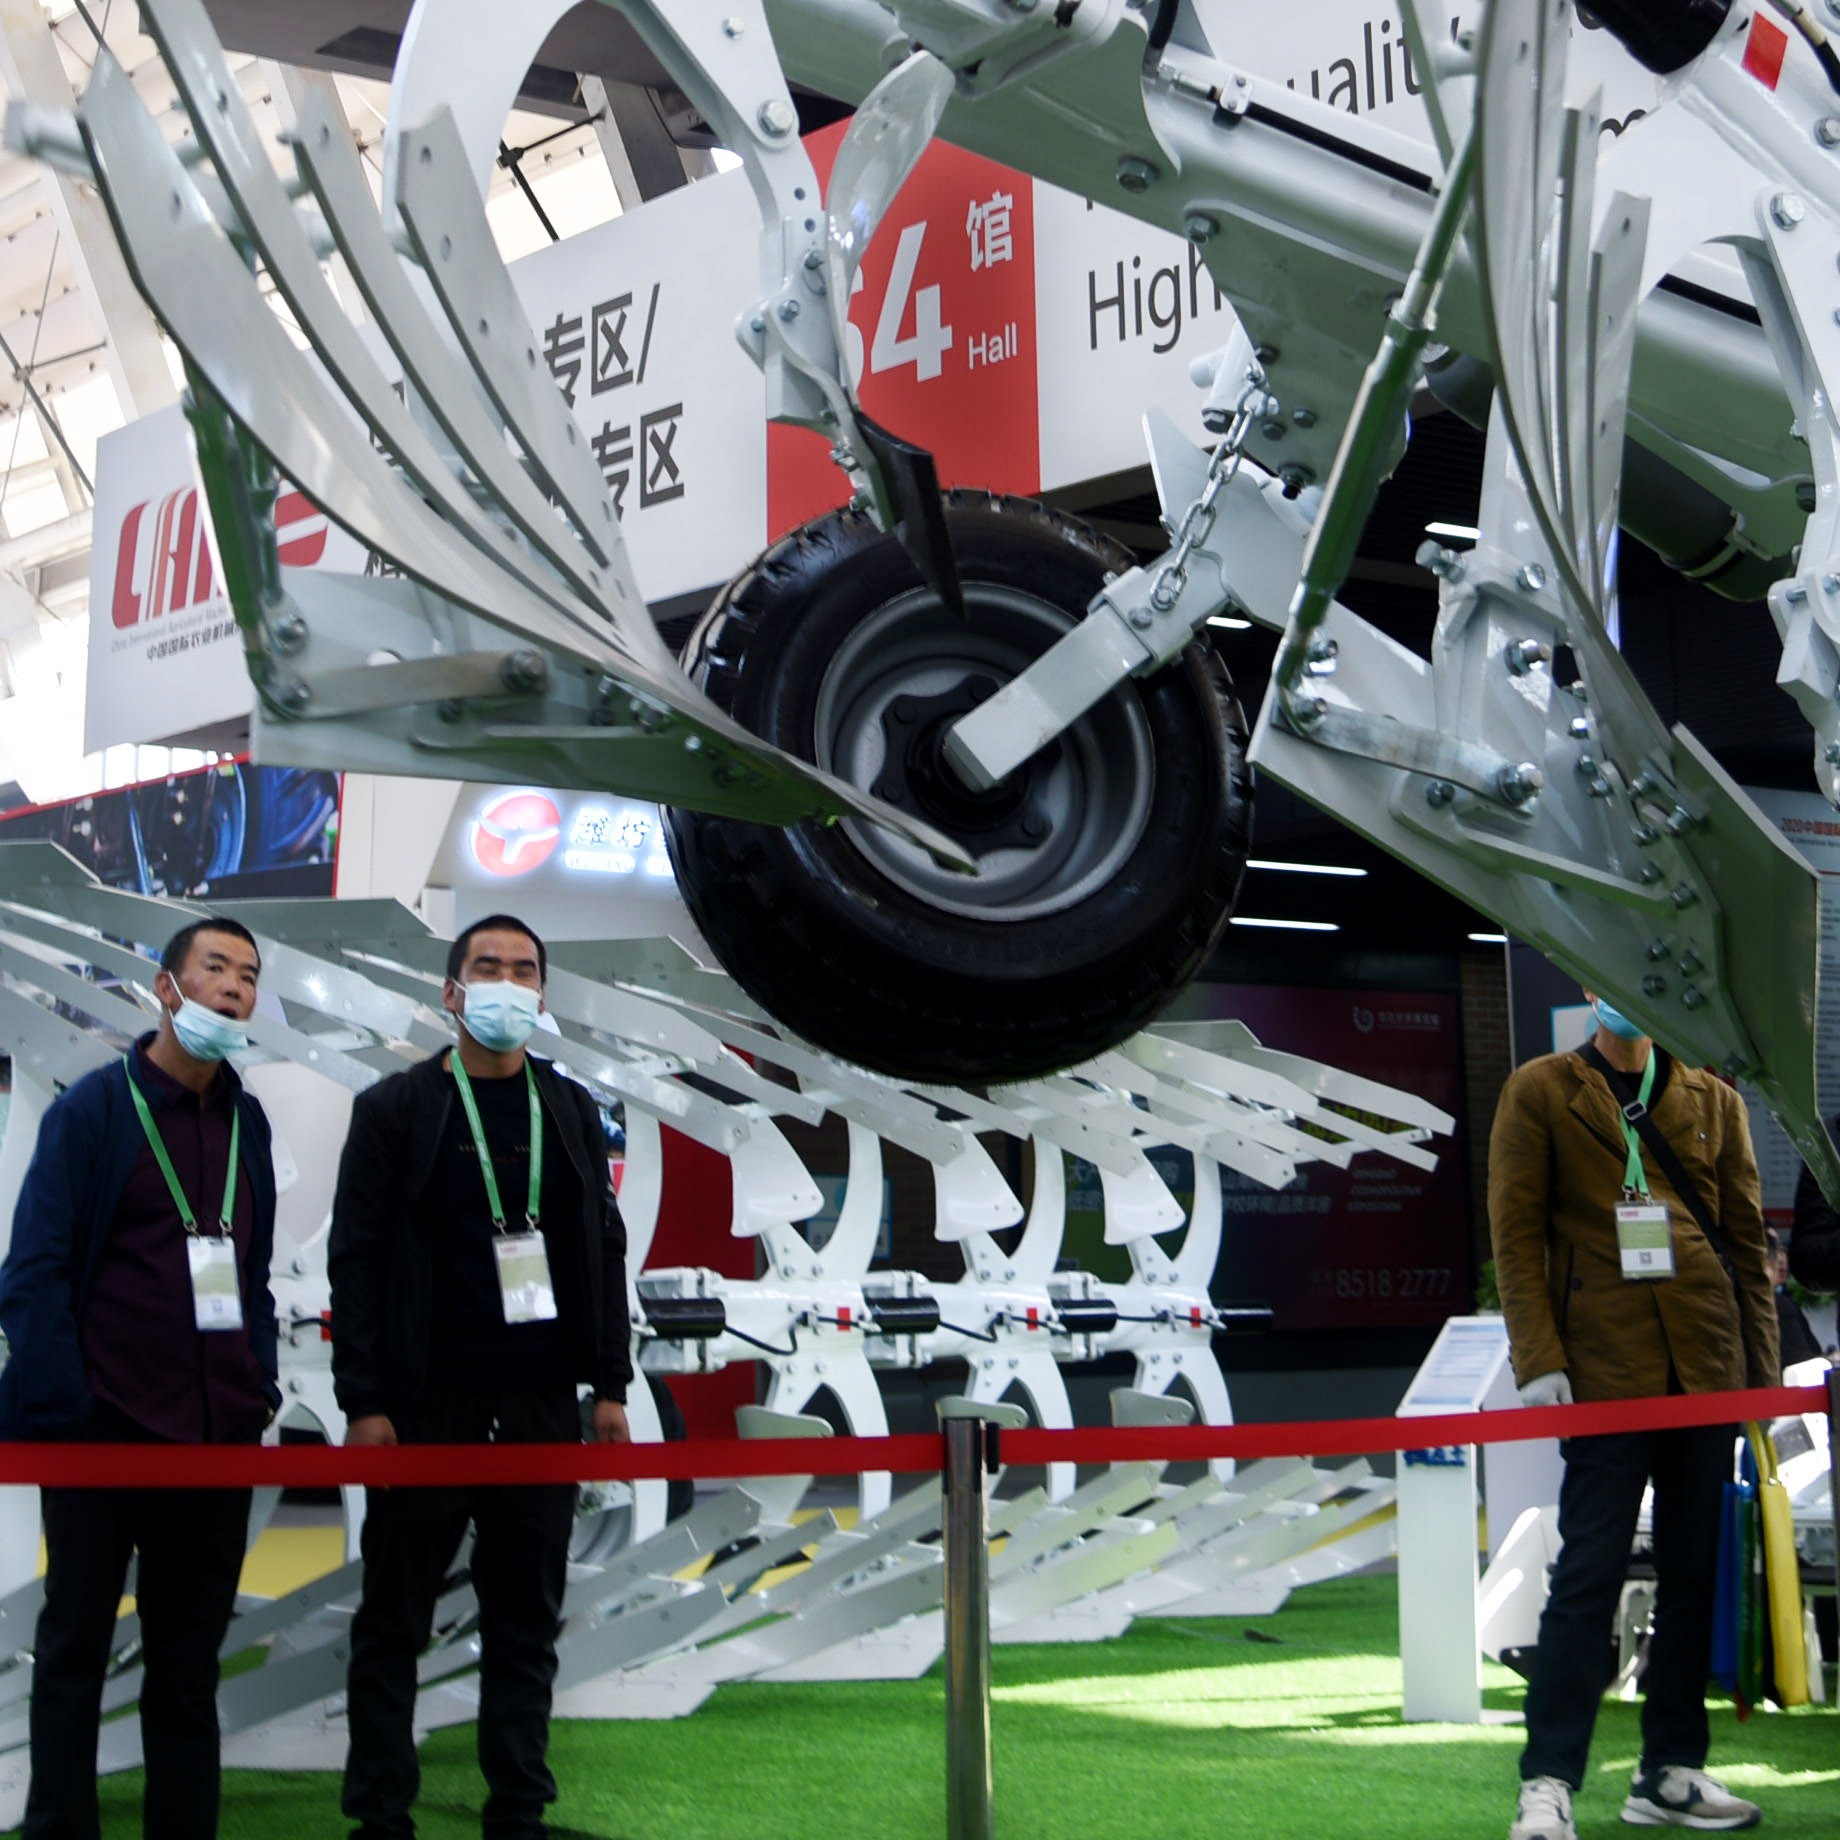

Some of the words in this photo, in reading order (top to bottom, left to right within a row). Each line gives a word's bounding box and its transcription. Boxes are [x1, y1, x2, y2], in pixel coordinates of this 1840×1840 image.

[966, 190, 1013, 272] 馆
[846, 221, 952, 394] 4
[968, 322, 1017, 369] Hall
